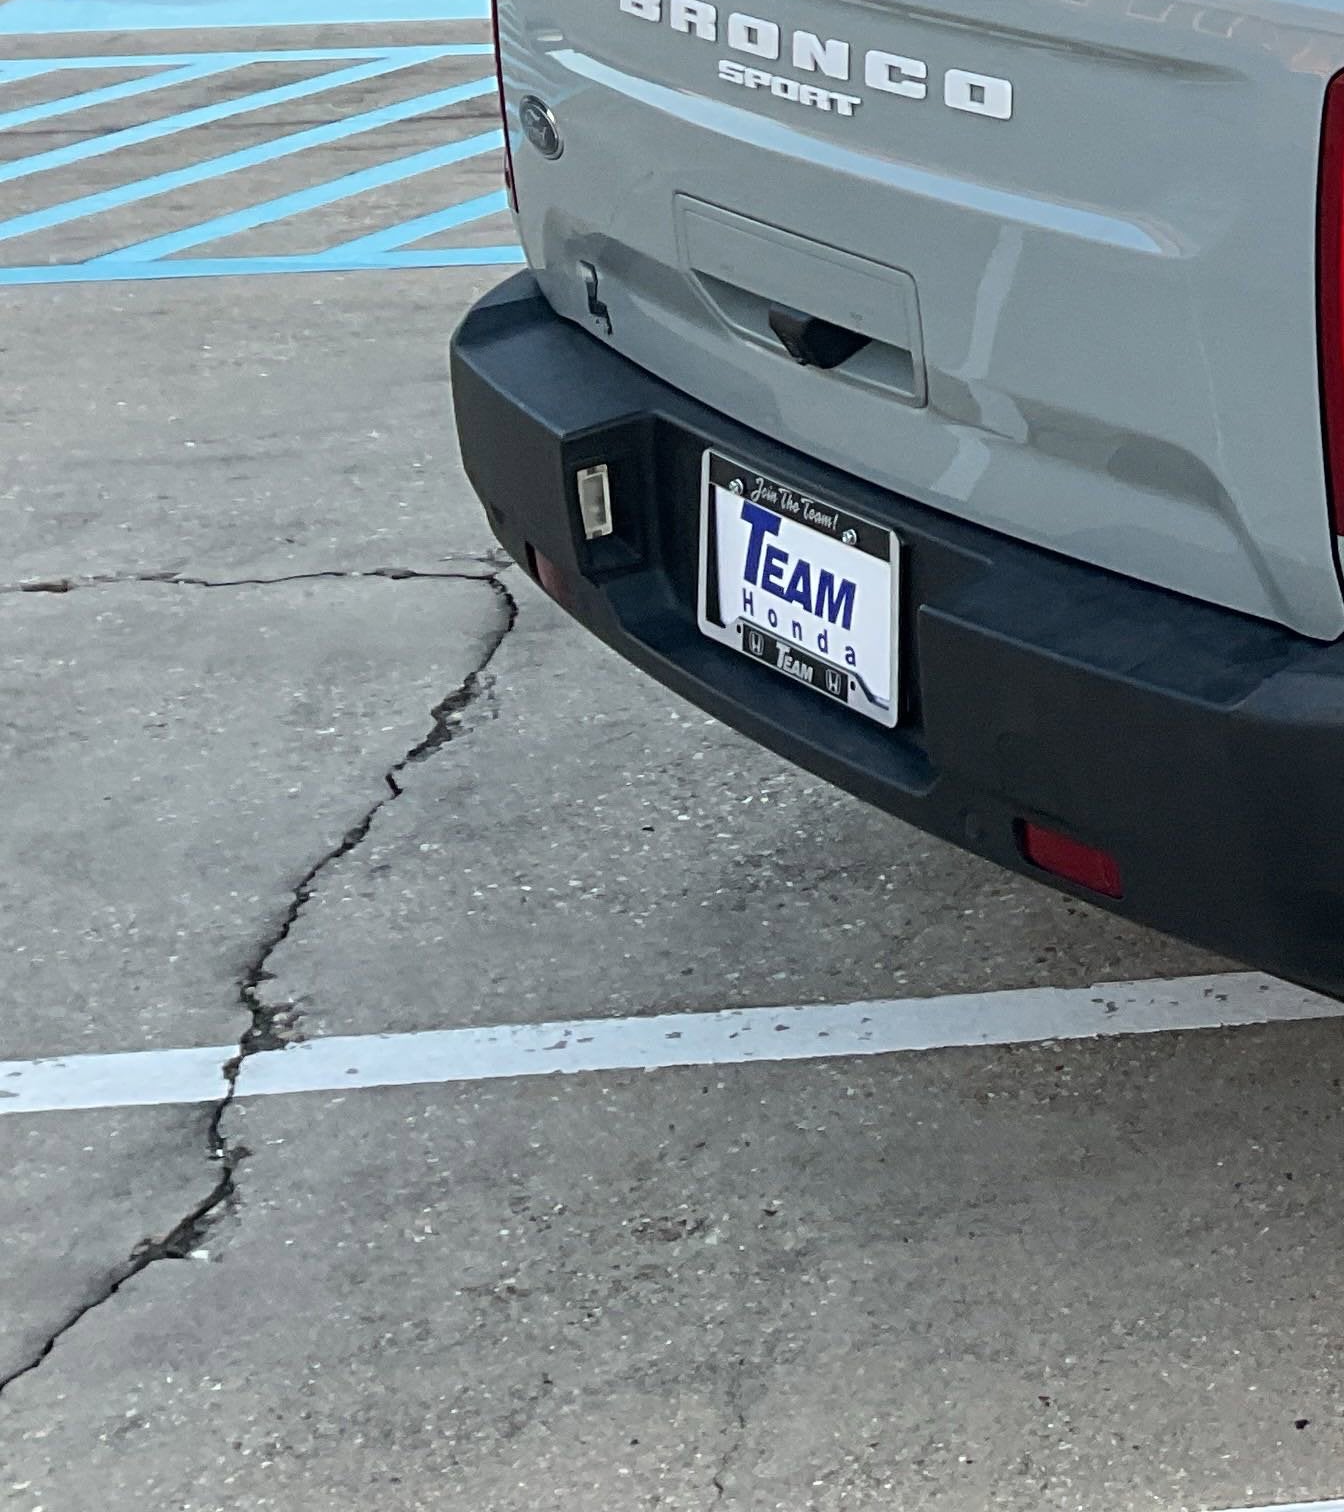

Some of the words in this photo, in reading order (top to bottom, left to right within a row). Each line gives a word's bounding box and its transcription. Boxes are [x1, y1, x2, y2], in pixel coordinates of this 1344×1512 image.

[717, 59, 863, 116] SPORT
[750, 477, 778, 504] Join
[779, 488, 801, 514] The
[800, 498, 839, 531] Team!
[741, 500, 857, 630] TEAM
[742, 588, 857, 666] Honda
[776, 643, 813, 684] TEAM
